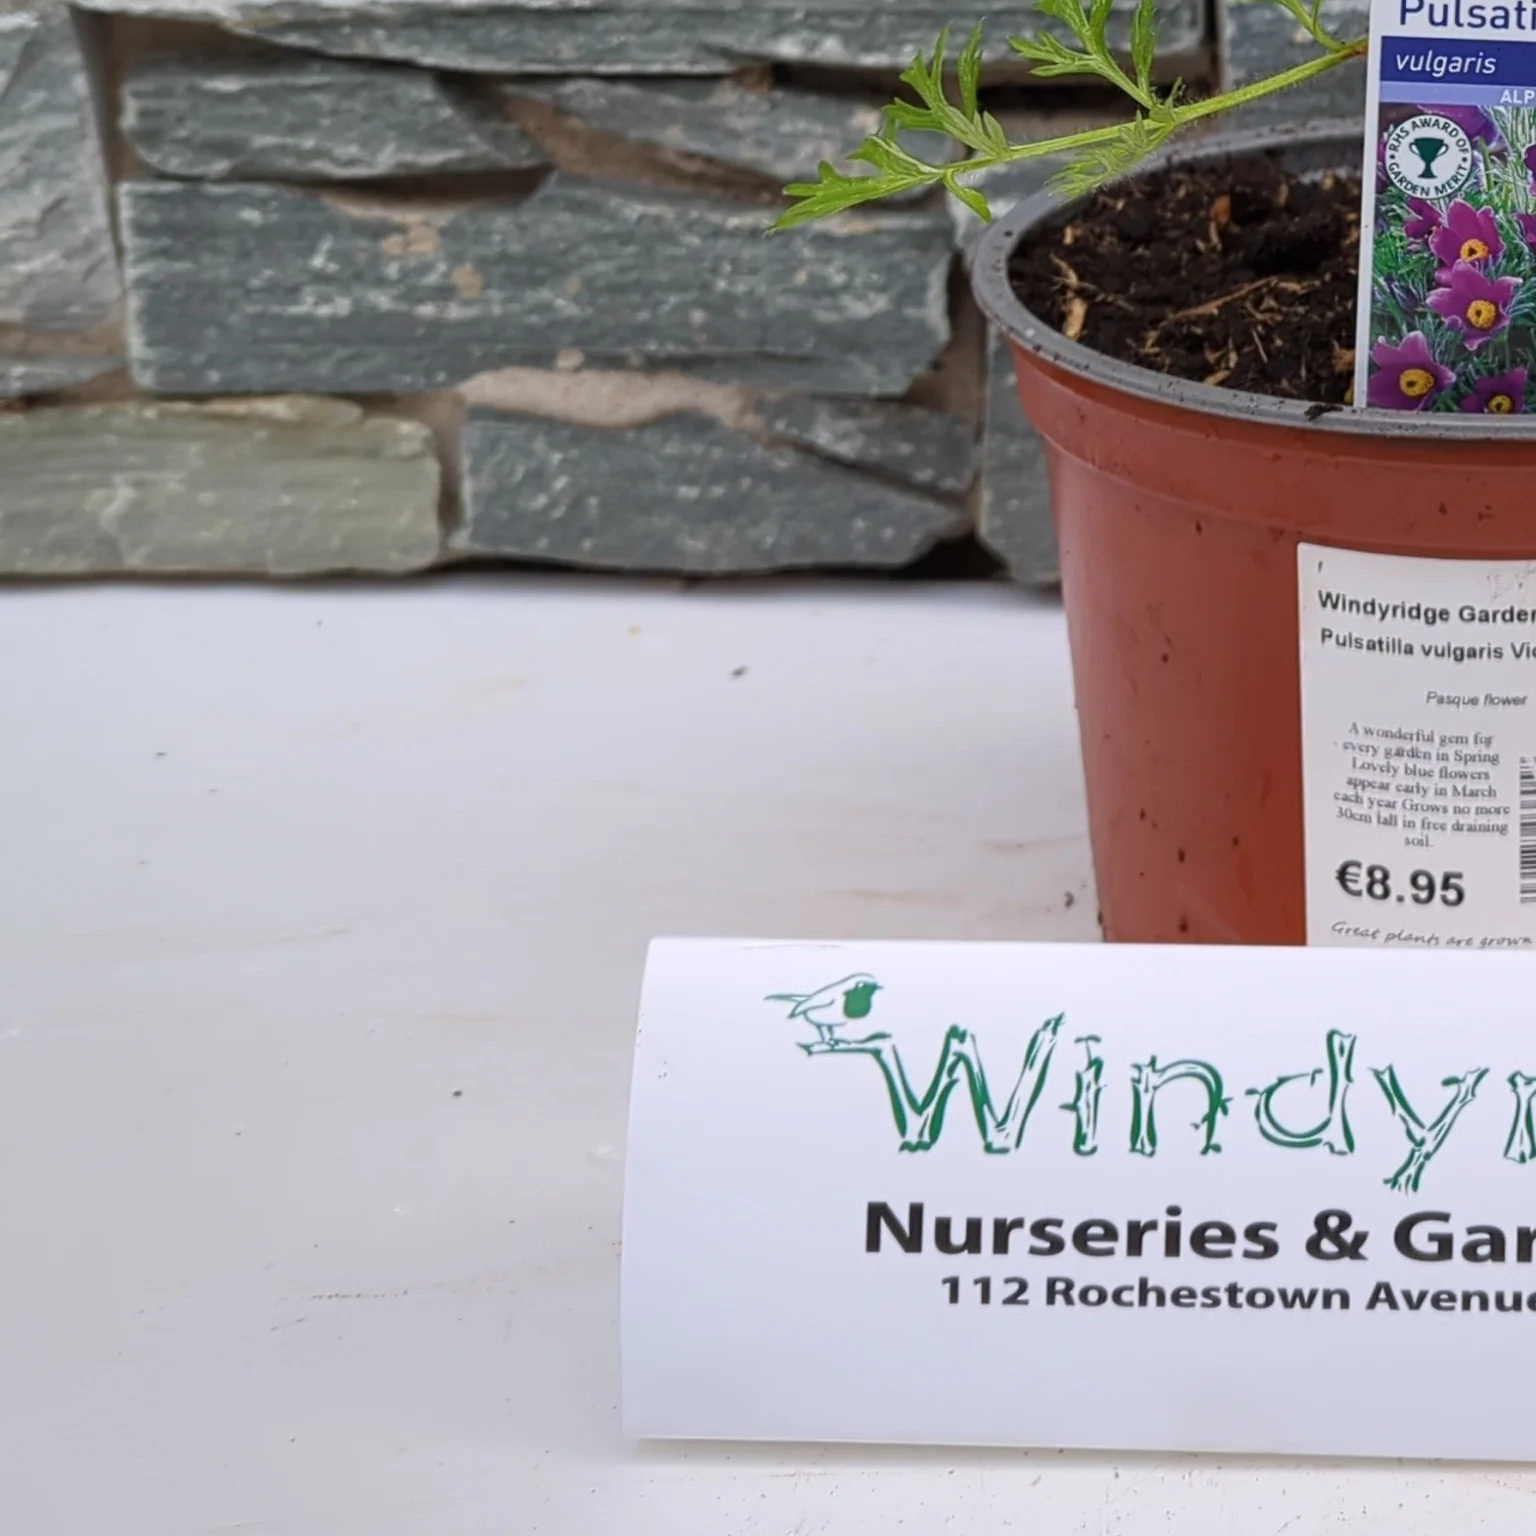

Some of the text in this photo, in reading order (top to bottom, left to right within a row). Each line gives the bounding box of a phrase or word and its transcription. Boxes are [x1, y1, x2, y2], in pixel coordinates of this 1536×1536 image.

[1395, 50, 1497, 77] vulgaris
[1388, 117, 1470, 154] RHS AWARD OF
[1388, 162, 1467, 197] GARDEN MERIT
[1318, 589, 1450, 626] Windyridge
[1320, 628, 1414, 656] Pulsatilla
[1420, 641, 1504, 663] vulgaris
[1426, 690, 1528, 709] Pasque flower
[1348, 721, 1494, 748] A wonderful gem for
[1342, 741, 1500, 767] every garden in Spring
[1351, 756, 1490, 781] Lovely blue flowers
[1346, 775, 1497, 798] appear early in March
[1333, 790, 1511, 815] each year Grows no more
[1336, 806, 1372, 824] 30cm
[1402, 815, 1416, 829] in
[1421, 817, 1447, 831] free
[1451, 820, 1508, 836] draining
[1404, 835, 1434, 848] soil.
[1335, 859, 1466, 907] €8.95
[1331, 921, 1380, 940] Great
[1384, 928, 1439, 946] plants
[1446, 936, 1473, 946] are
[1478, 935, 1533, 949] grown
[864, 1200, 1281, 1261] Nurseries
[1304, 1207, 1370, 1263] &
[941, 1274, 1029, 1306] 112
[1045, 1276, 1351, 1311] Rochestown
